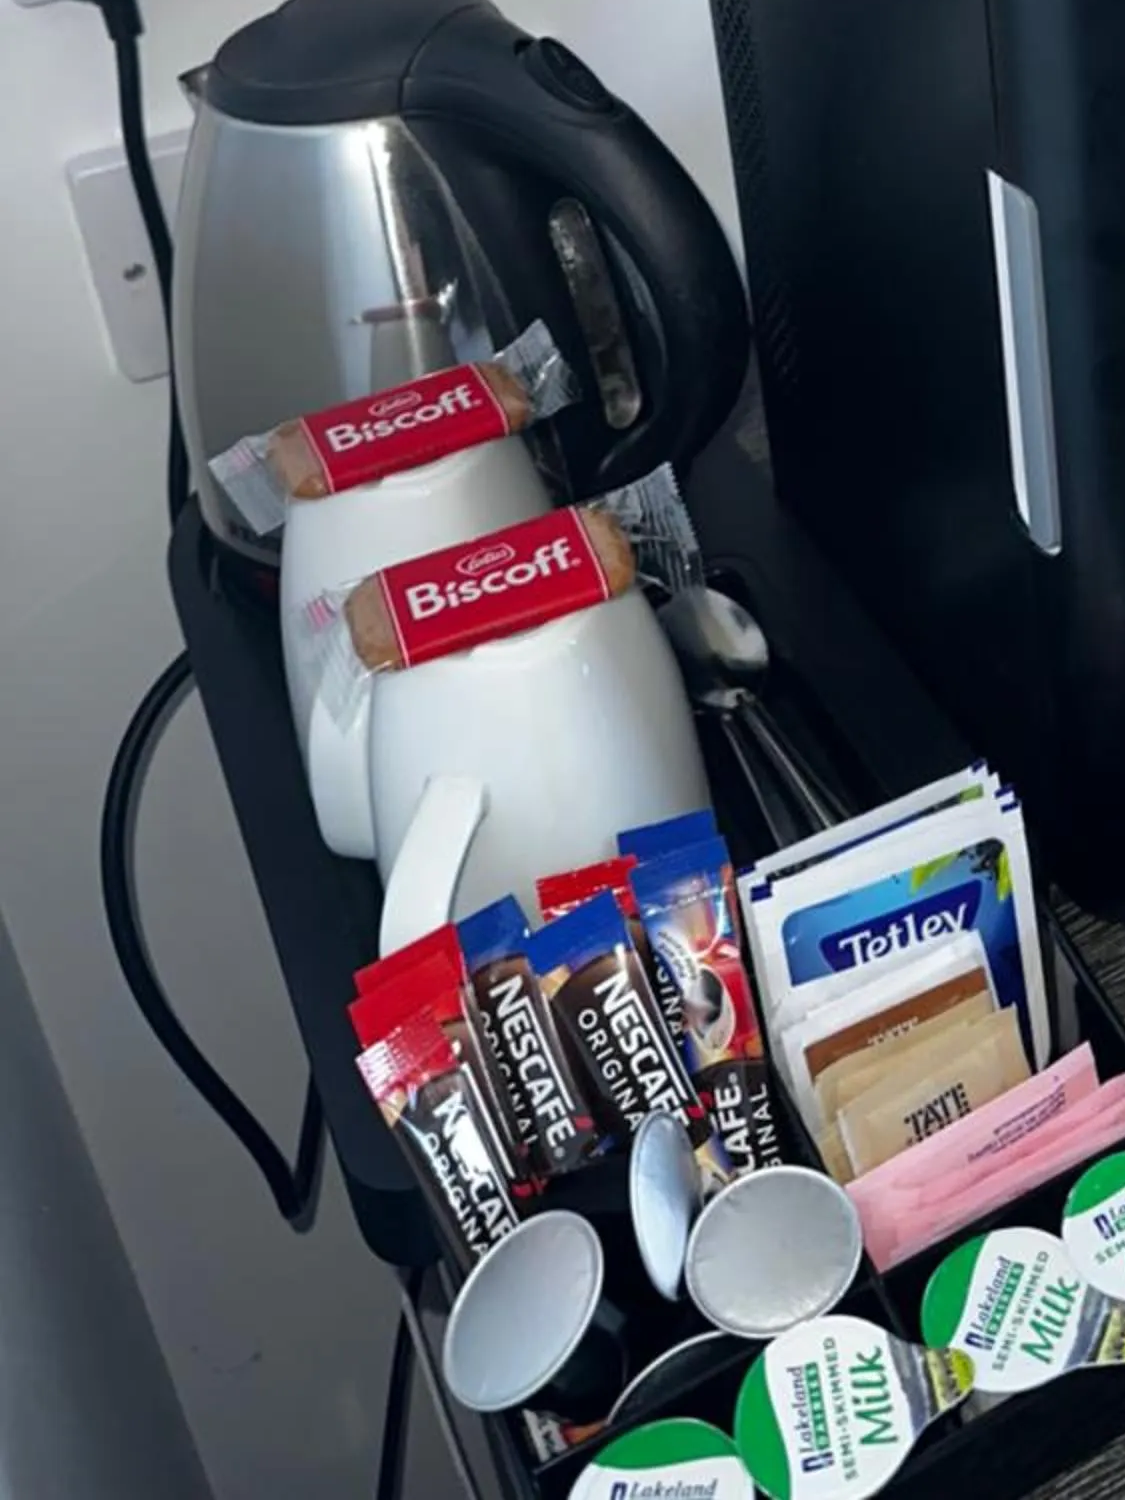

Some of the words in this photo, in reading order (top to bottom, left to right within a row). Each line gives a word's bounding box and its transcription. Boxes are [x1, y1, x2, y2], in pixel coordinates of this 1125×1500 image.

[325, 384, 473, 452] Biscoff
[405, 537, 571, 620] Biscoff
[838, 902, 967, 967] Tetley
[578, 1008, 646, 1132] ORIGINA
[903, 1082, 972, 1143] TATE
[432, 1091, 514, 1241] NSCAF
[750, 1082, 783, 1170] GINAL
[423, 1131, 489, 1257] ORIGINA
[970, 1255, 1012, 1332] Lakeland
[992, 1251, 1049, 1371] SEMI-SKIMMED
[1020, 1277, 1081, 1364] Milk
[786, 1365, 814, 1453] Lakeland
[823, 1336, 859, 1482] SEMI-SKIMMED
[849, 1345, 898, 1445] Milk
[630, 1477, 719, 1499] Lakeland
